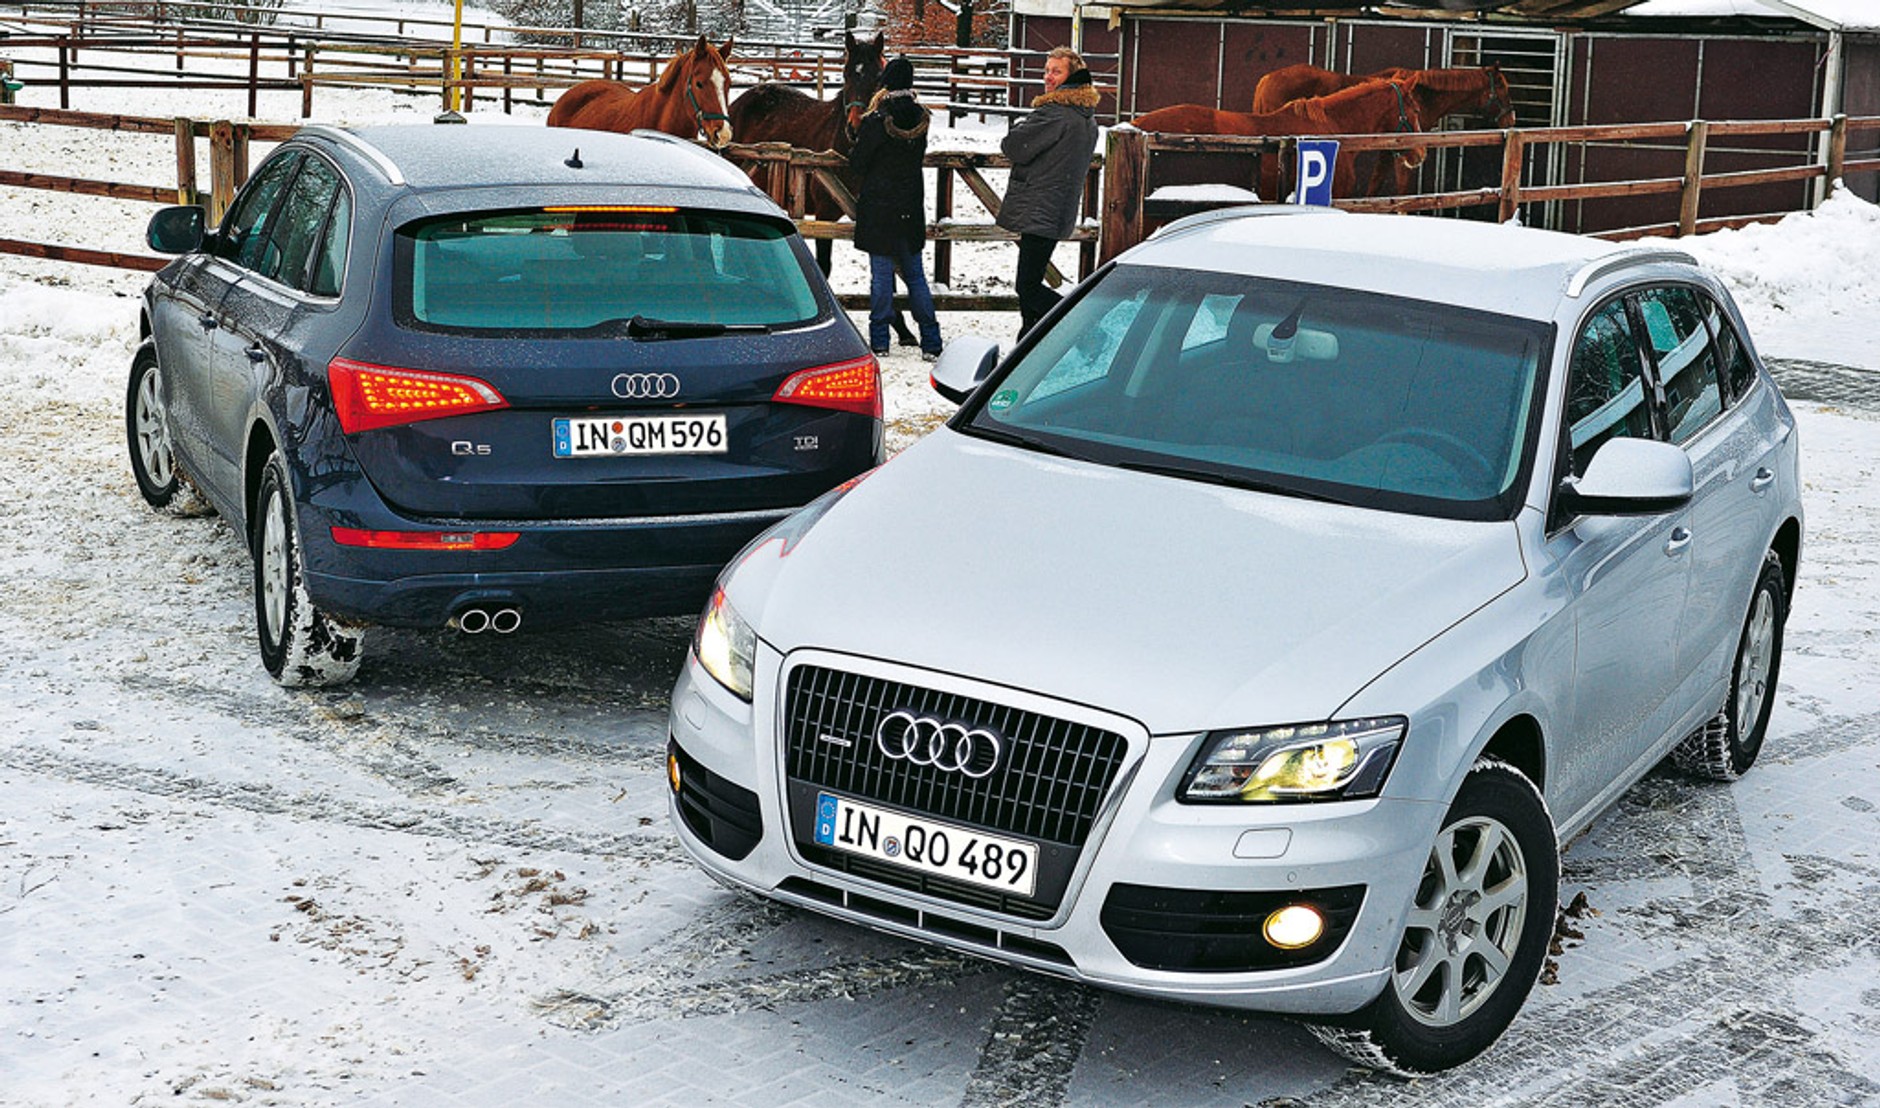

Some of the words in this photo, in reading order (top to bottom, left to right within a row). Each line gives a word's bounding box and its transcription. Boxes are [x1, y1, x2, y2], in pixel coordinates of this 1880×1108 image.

[1299, 150, 1327, 206] P
[559, 441, 567, 450] D
[576, 422, 609, 451] IN
[628, 421, 666, 449] QM
[671, 420, 721, 448] 596
[451, 440, 492, 456] Q5
[822, 822, 830, 836] D
[838, 806, 881, 851] IN
[904, 824, 949, 868] QO
[958, 838, 1028, 886] 489
